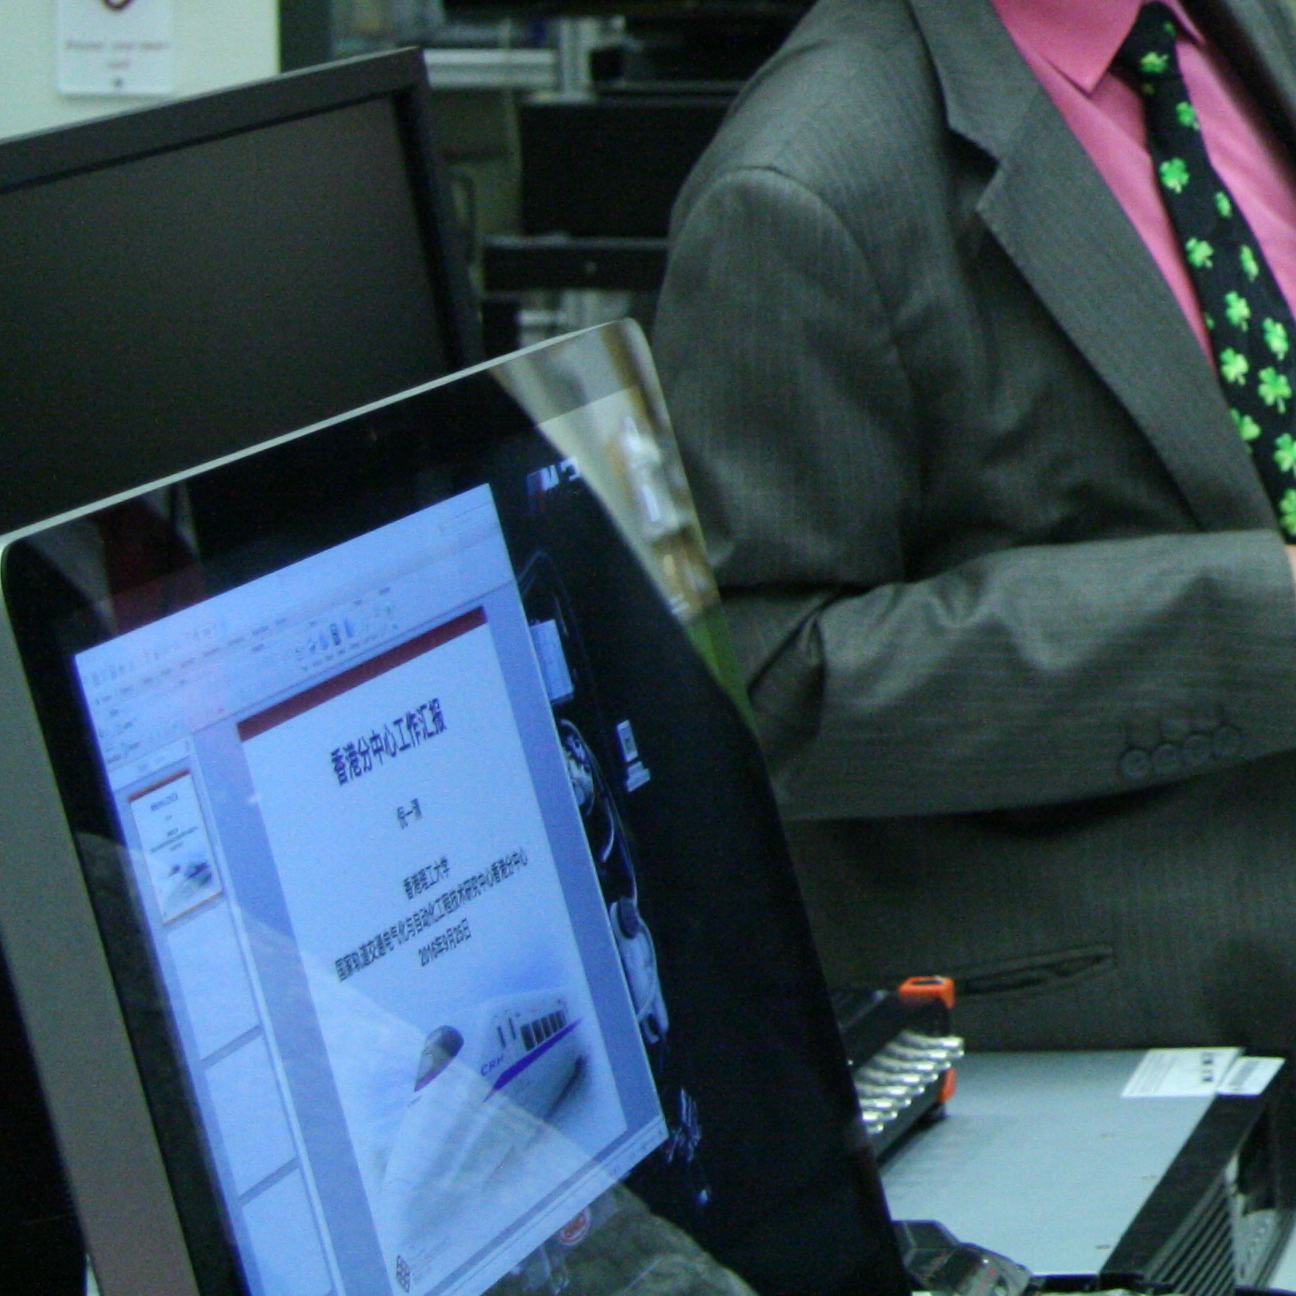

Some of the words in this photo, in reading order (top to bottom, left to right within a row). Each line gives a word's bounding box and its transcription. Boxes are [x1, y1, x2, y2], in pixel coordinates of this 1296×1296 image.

[331, 698, 447, 786] 香港分中心工作汇报
